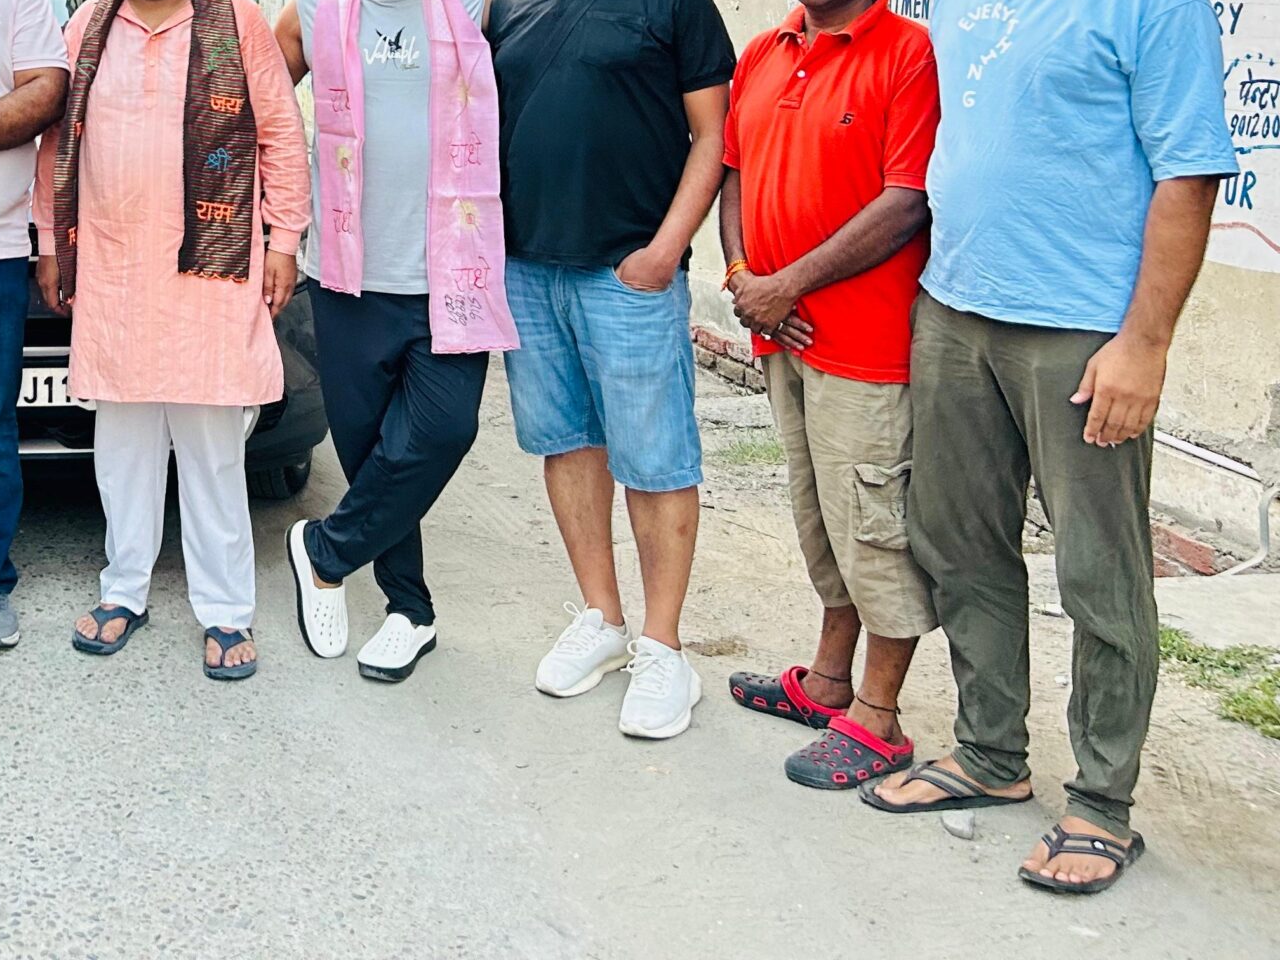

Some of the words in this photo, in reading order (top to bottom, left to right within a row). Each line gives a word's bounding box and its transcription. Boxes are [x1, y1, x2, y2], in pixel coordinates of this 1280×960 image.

[210, 95, 245, 115] जय
[205, 147, 232, 174] श्री
[196, 200, 234, 224] राम
